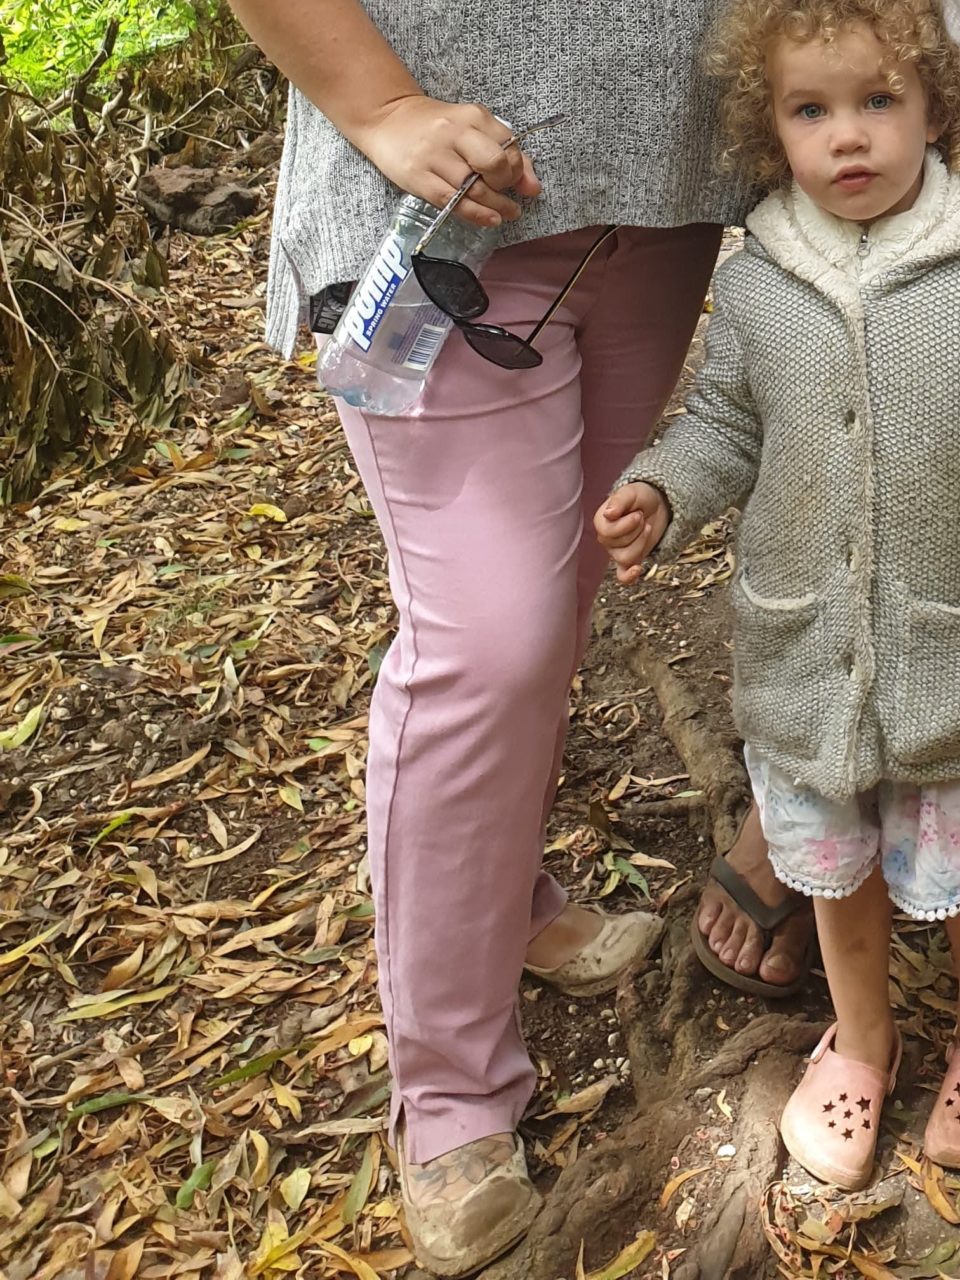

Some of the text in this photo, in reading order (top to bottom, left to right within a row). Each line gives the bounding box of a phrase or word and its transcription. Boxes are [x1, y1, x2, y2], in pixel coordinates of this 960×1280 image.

[337, 231, 409, 353] pump
[365, 283, 397, 337] SPRING WATER
